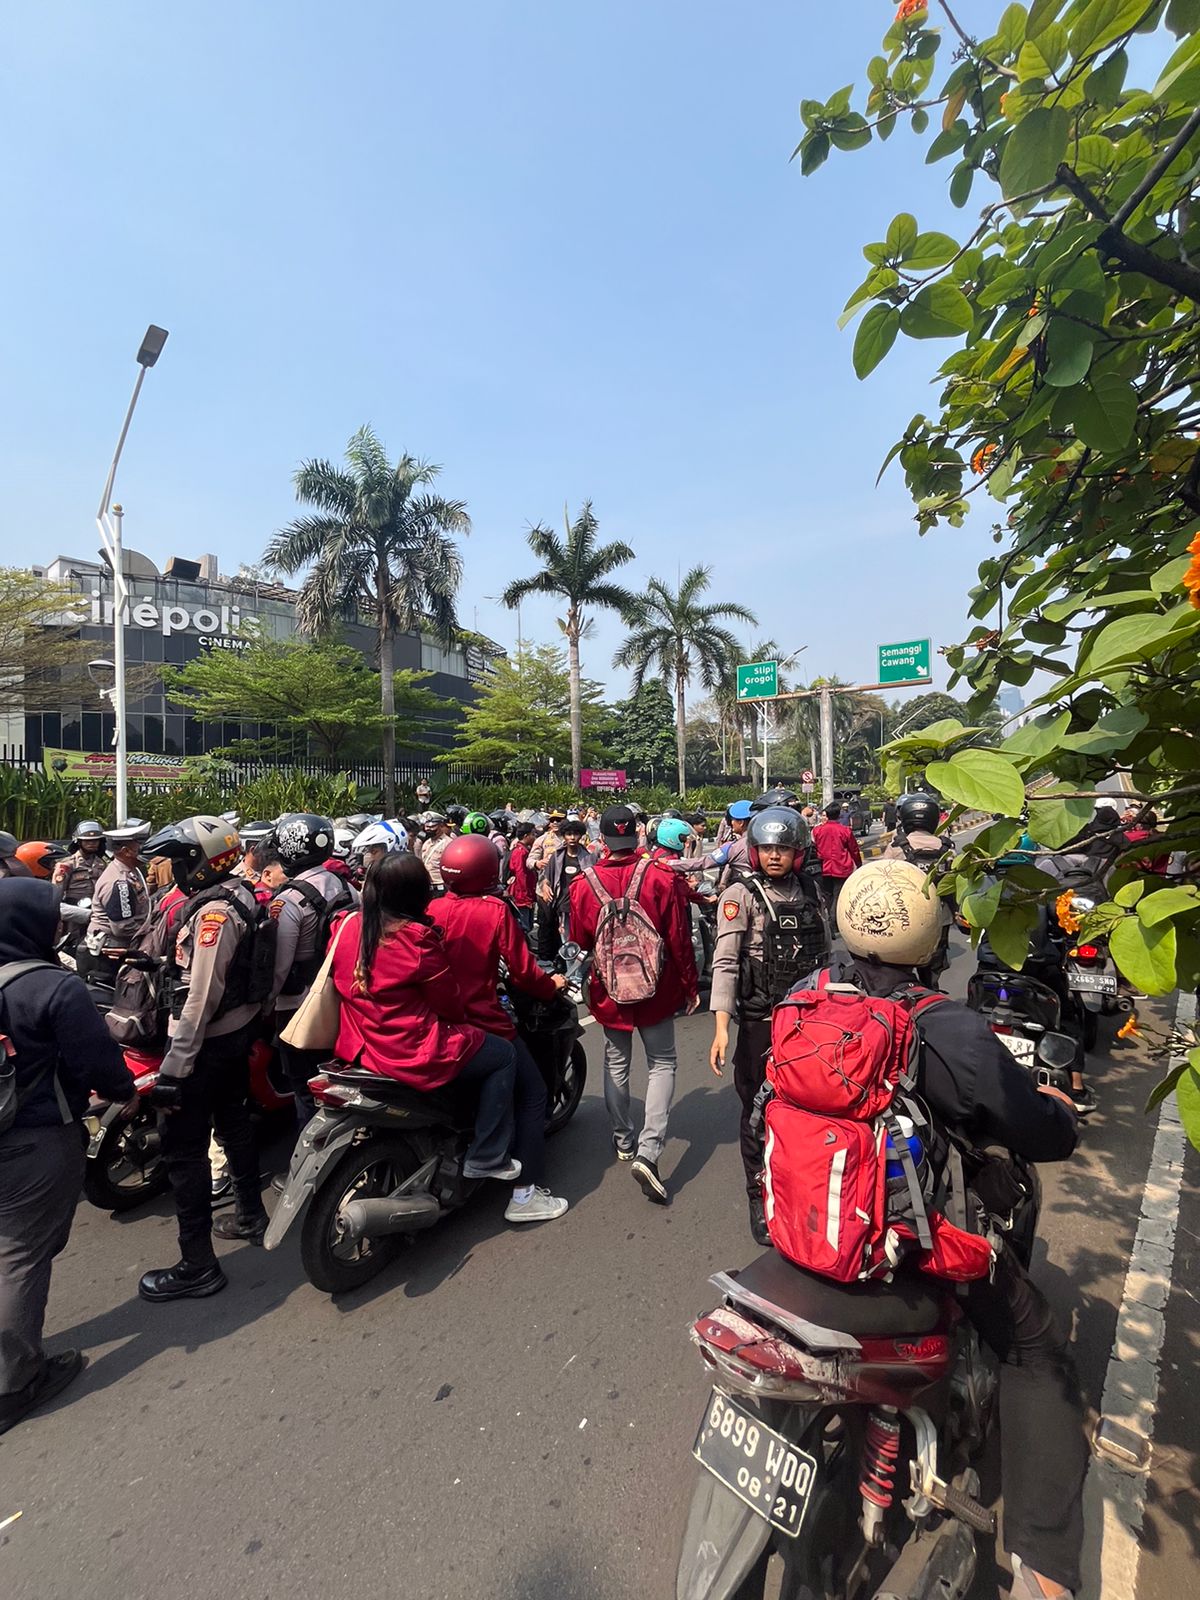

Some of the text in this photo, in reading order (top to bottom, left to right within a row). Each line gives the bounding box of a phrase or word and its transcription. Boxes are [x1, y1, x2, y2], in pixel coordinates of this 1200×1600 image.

[198, 636, 252, 651] CINEMA
[881, 643, 922, 657] Semanggi
[881, 657, 915, 667] Cawang
[754, 665, 774, 675] Slipi
[745, 674, 774, 685] Grogol
[709, 1395, 760, 1458] 6899
